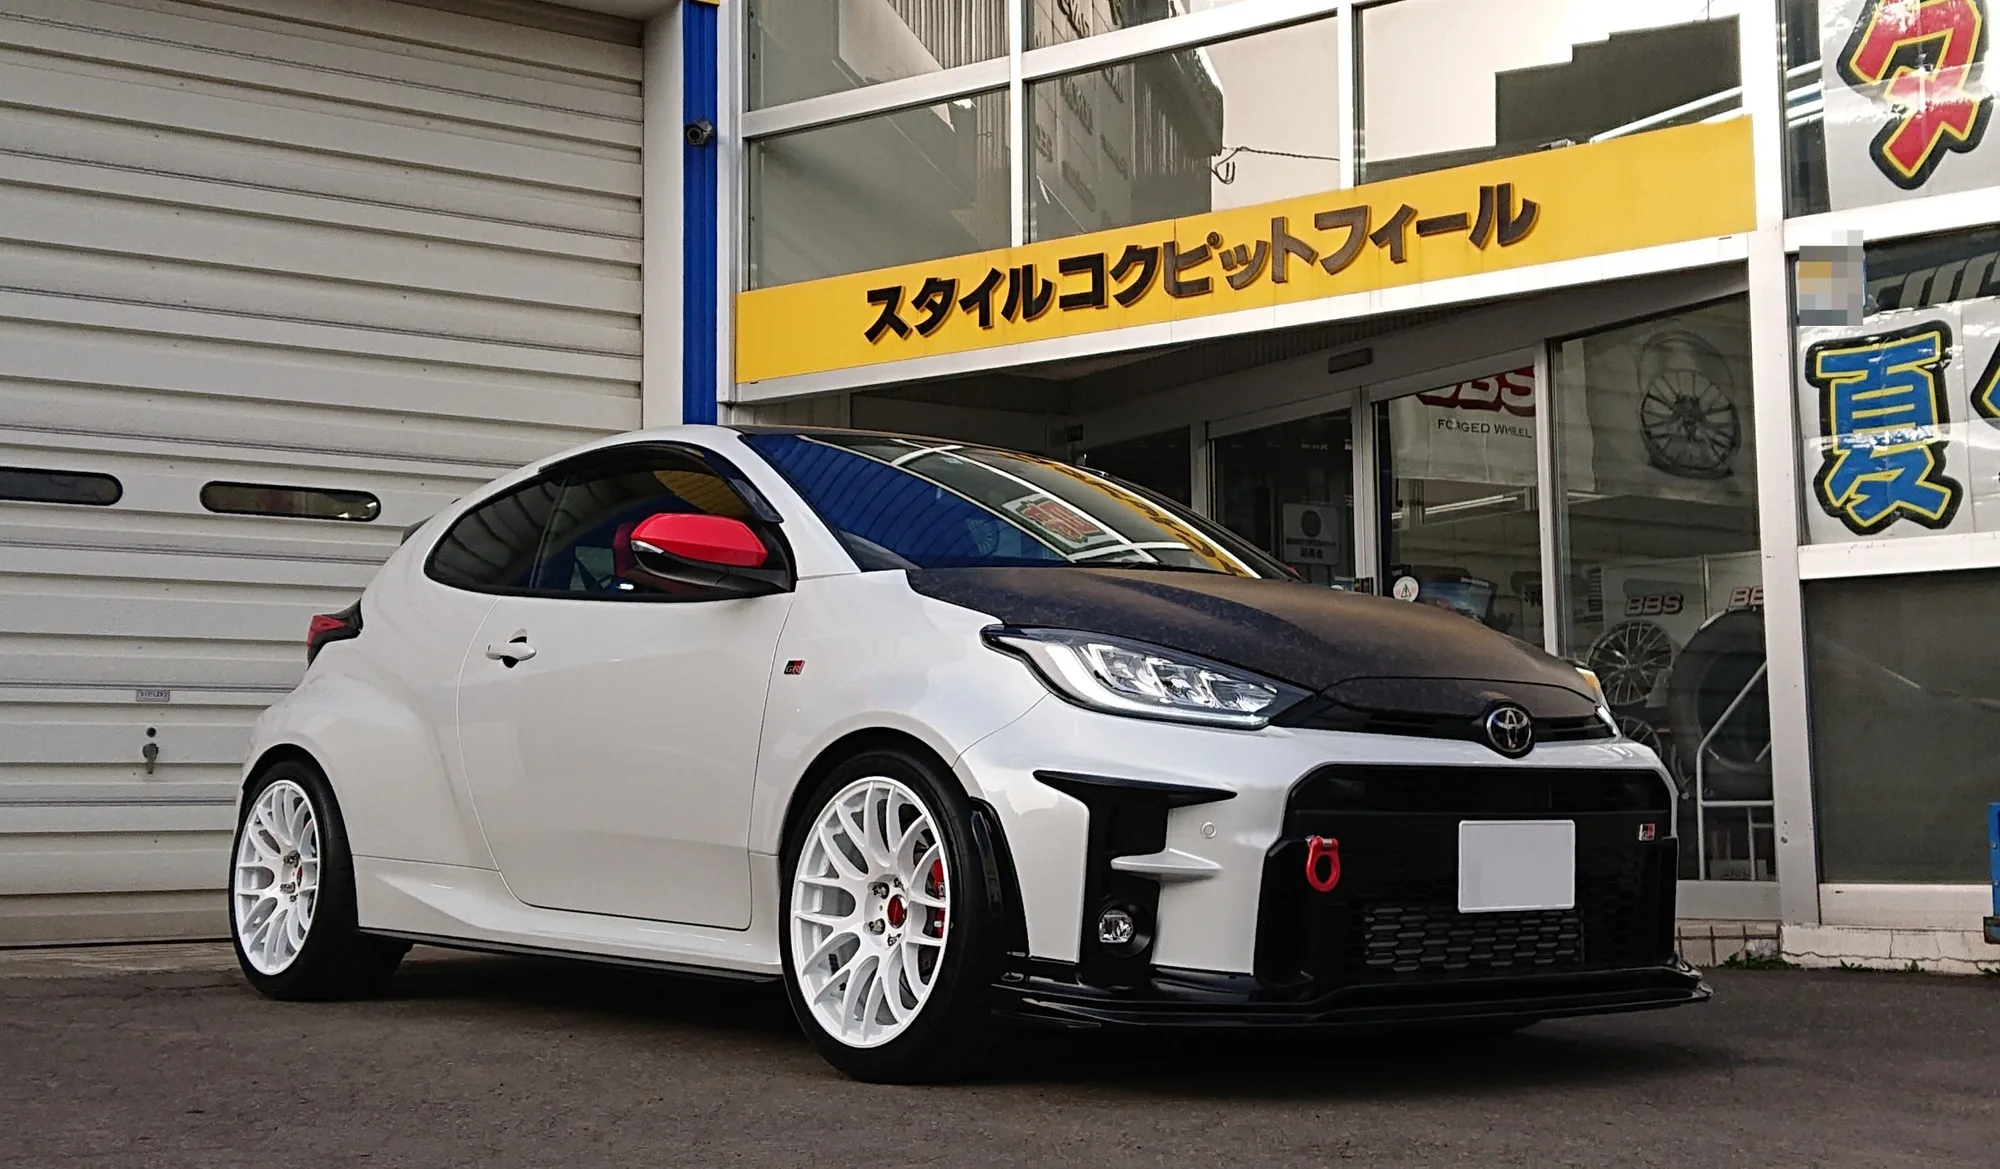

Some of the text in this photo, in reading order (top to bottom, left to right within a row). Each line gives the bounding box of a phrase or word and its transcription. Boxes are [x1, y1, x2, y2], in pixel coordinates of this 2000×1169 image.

[863, 182, 1539, 345] スタイルコクピットフィール
[1493, 424, 1533, 438] WHEEL
[1807, 322, 2000, 534] 夏
[1625, 592, 1684, 616] BBS
